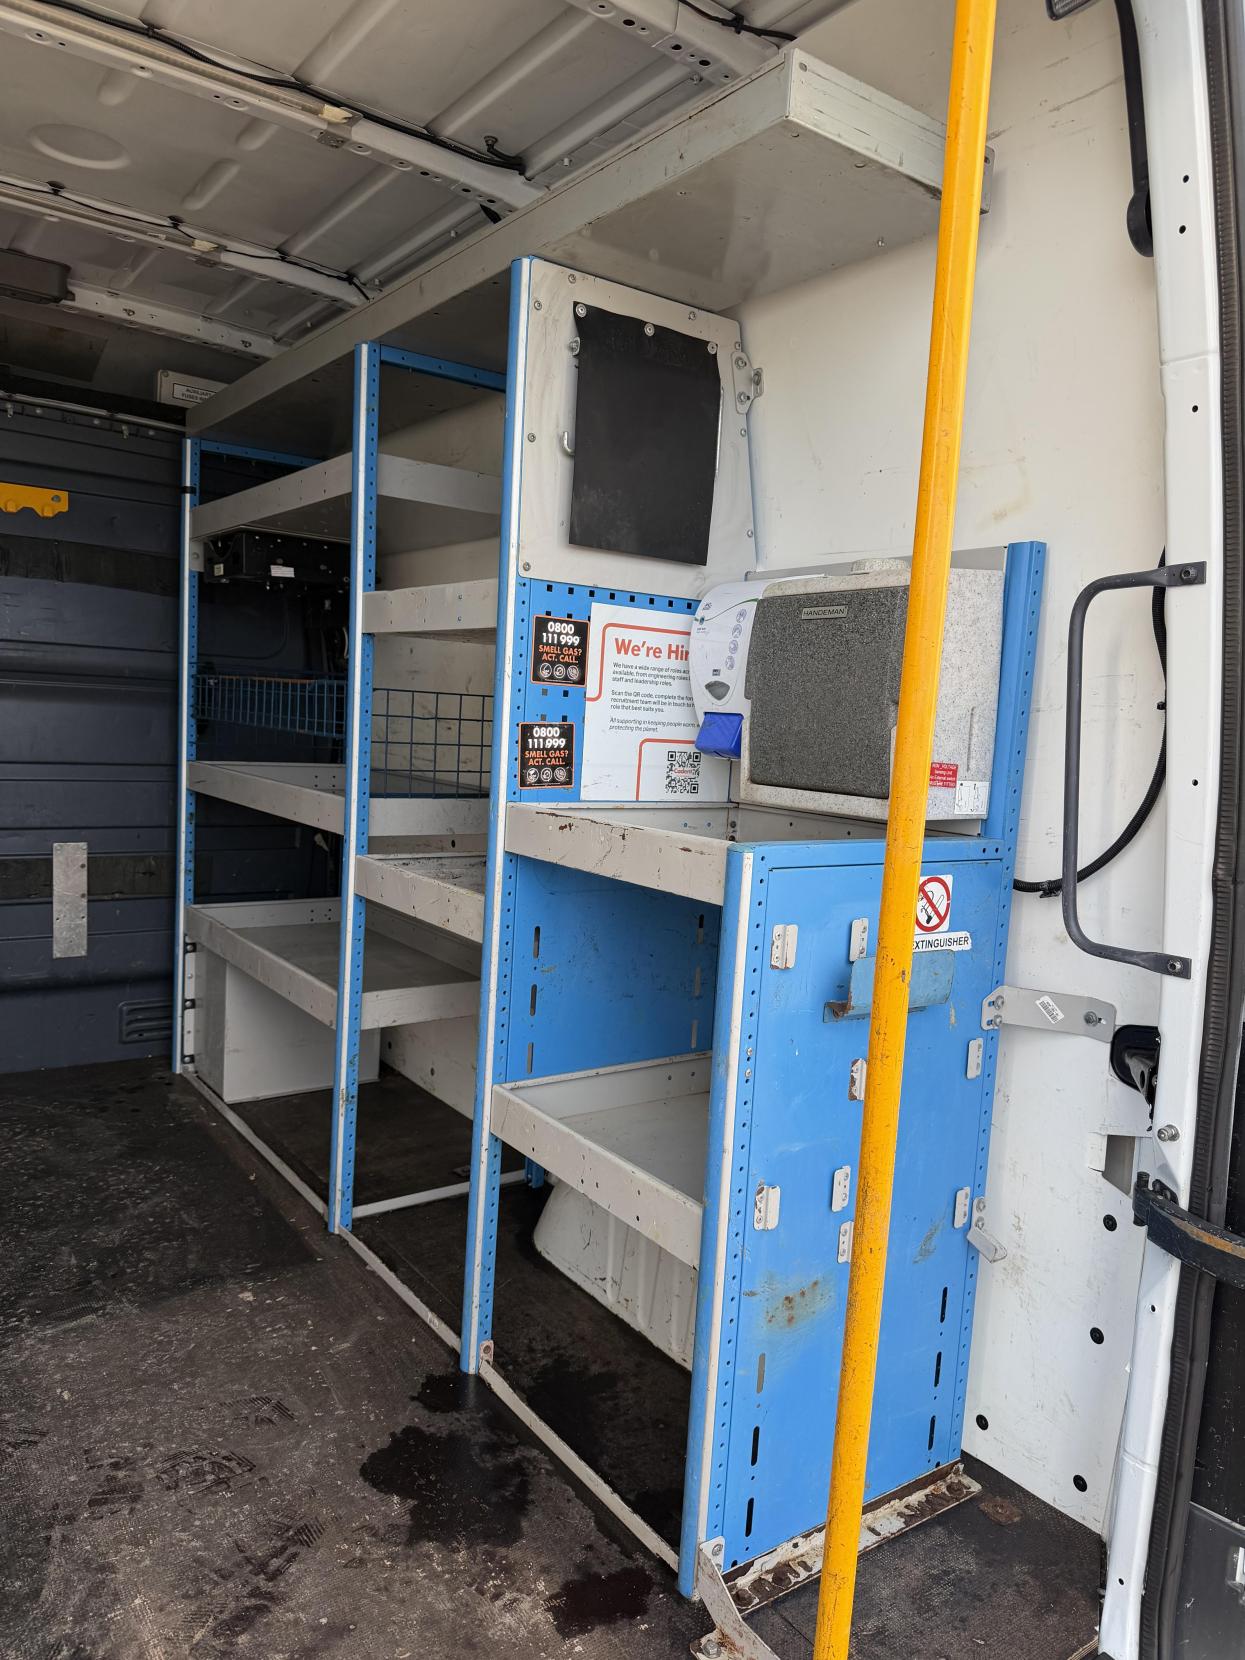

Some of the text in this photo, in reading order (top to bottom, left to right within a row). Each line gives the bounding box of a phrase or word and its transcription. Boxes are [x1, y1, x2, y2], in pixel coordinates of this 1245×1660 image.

[803, 608, 845, 616] HANDEMAN
[547, 621, 575, 634] 0800
[542, 632, 580, 646] 111 999
[538, 644, 583, 656] SMELL GAS?
[614, 638, 662, 658] We're
[541, 653, 579, 663] ACT. CALL.
[613, 661, 622, 669] We
[622, 662, 634, 670] have
[612, 669, 635, 677] available,
[635, 670, 648, 678] from
[648, 672, 676, 681] engineering
[634, 678, 659, 686] leadership
[532, 726, 561, 738] 0800
[527, 738, 566, 749] 111 999
[524, 750, 569, 758] SMELL GAS?
[528, 758, 566, 766] ACT. CALL.
[912, 936, 970, 950] XTINGUISHER
